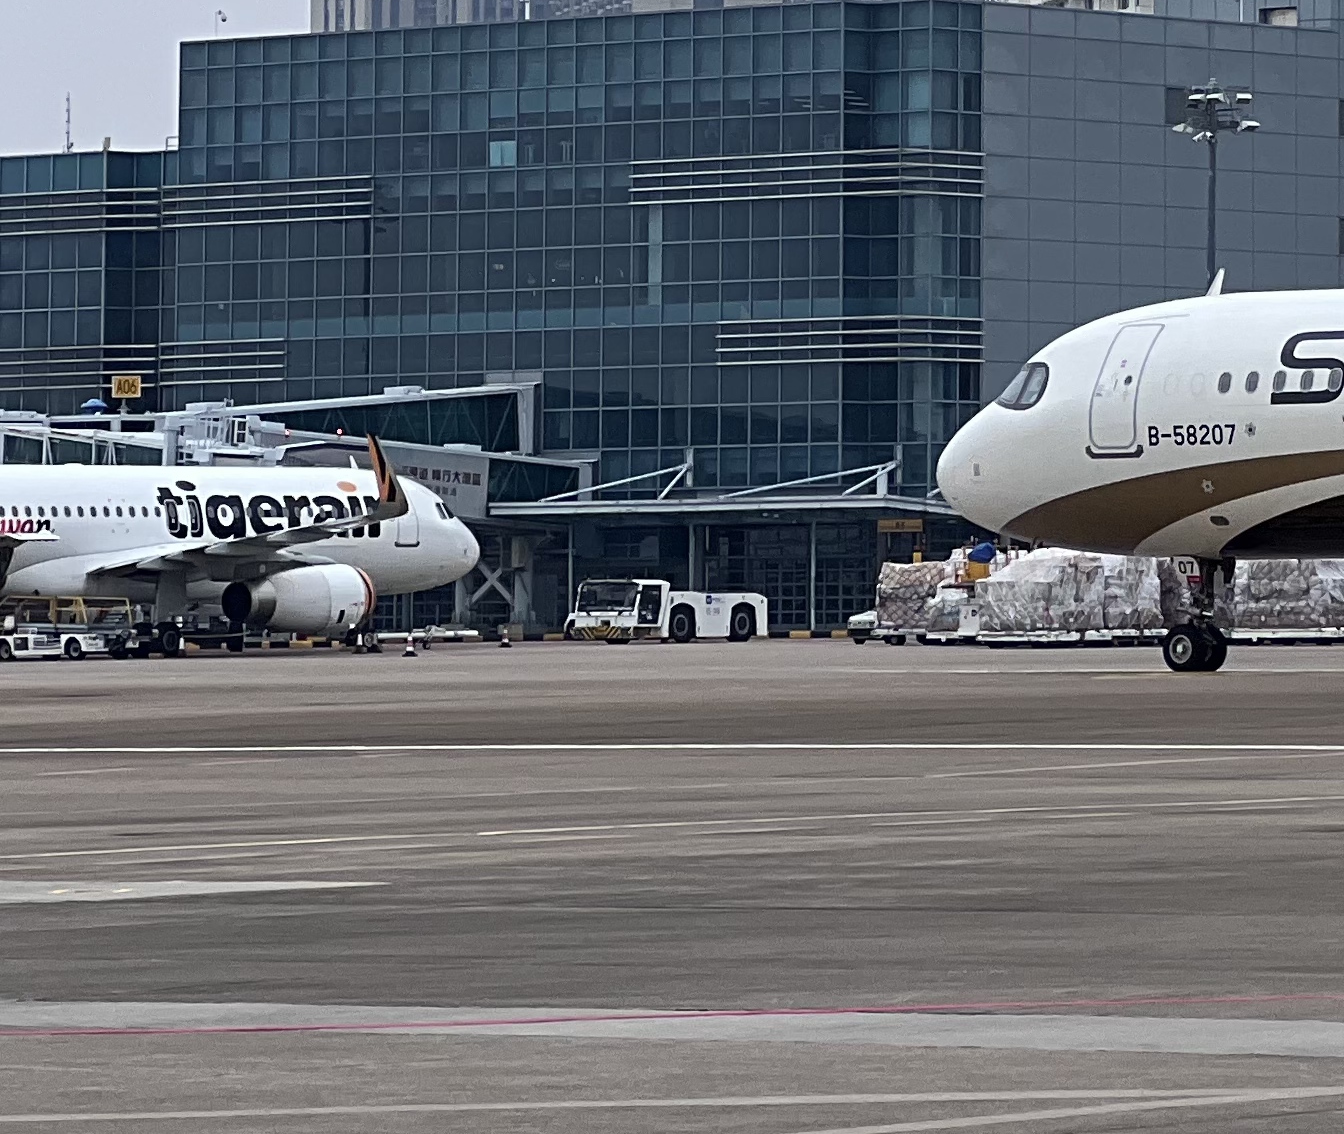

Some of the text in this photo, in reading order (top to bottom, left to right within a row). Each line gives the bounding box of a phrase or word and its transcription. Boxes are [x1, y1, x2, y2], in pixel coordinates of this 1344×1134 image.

[116, 378, 138, 395] A06
[1147, 424, 1236, 447] B-58207
[1178, 560, 1194, 575] 07
